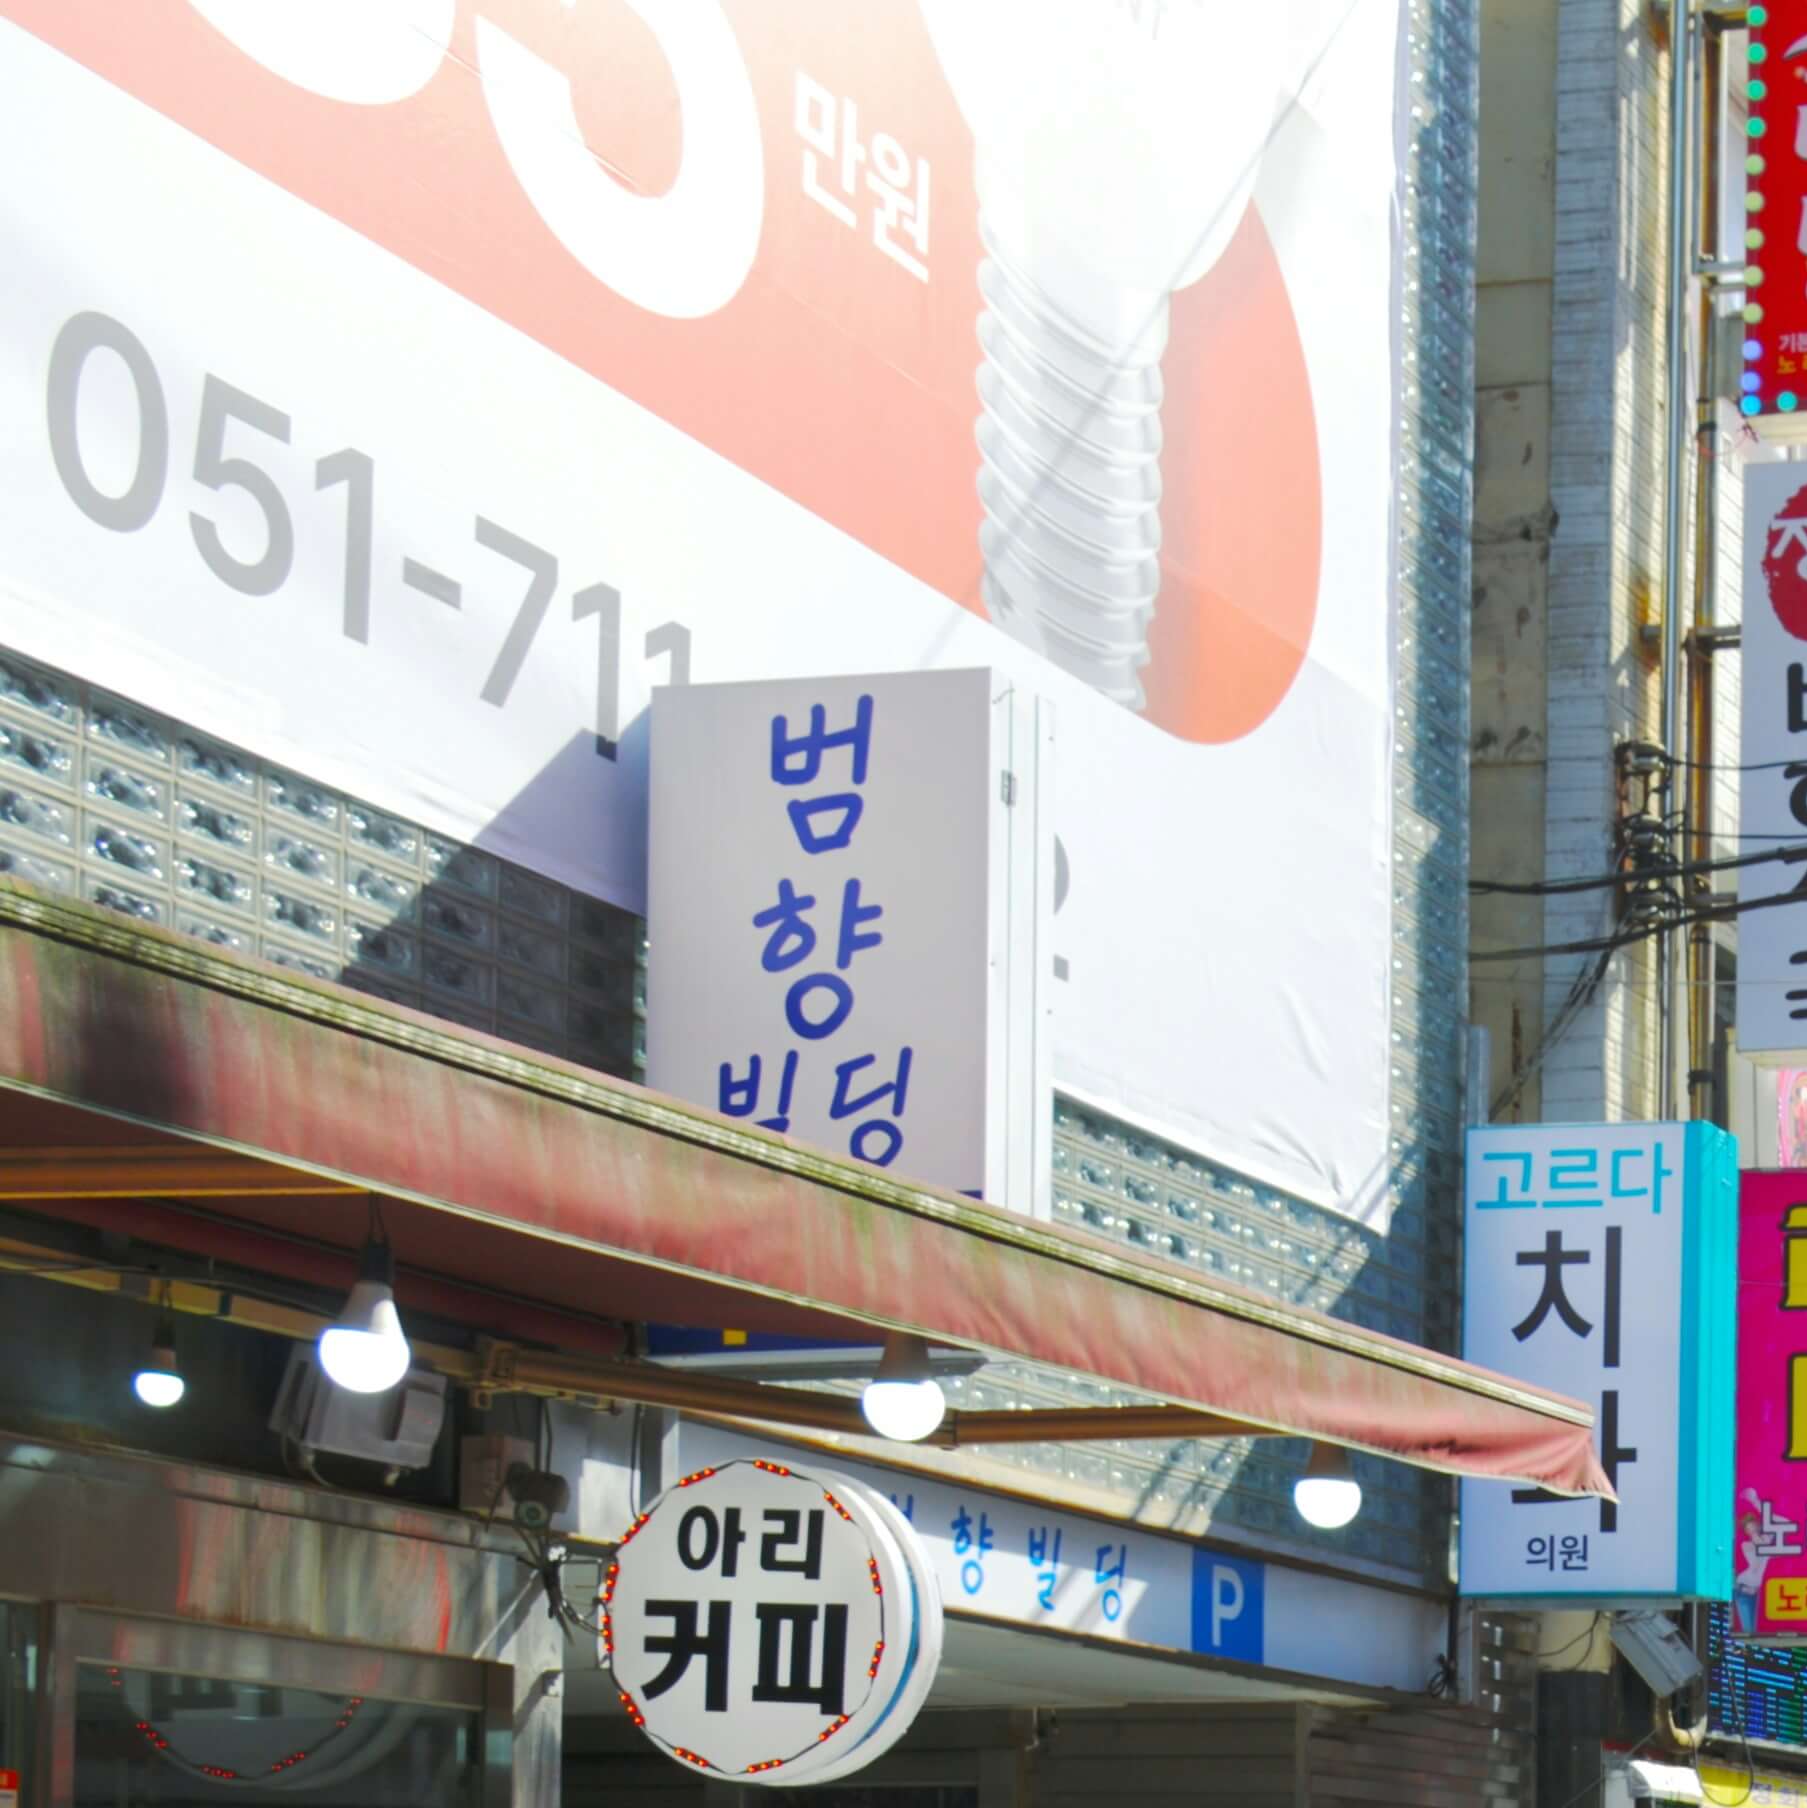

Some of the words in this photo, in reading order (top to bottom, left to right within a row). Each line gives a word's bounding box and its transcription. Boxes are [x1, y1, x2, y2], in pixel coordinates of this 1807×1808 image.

[794, 68, 929, 284] 만원
[1475, 1142, 1673, 1216] 고르다
[677, 1504, 826, 1581] 아리
[888, 1492, 1128, 1623] 향빌딩
[1525, 1534, 1590, 1572] 의원
[1211, 1567, 1245, 1649] P
[640, 1598, 850, 1717] 커피
